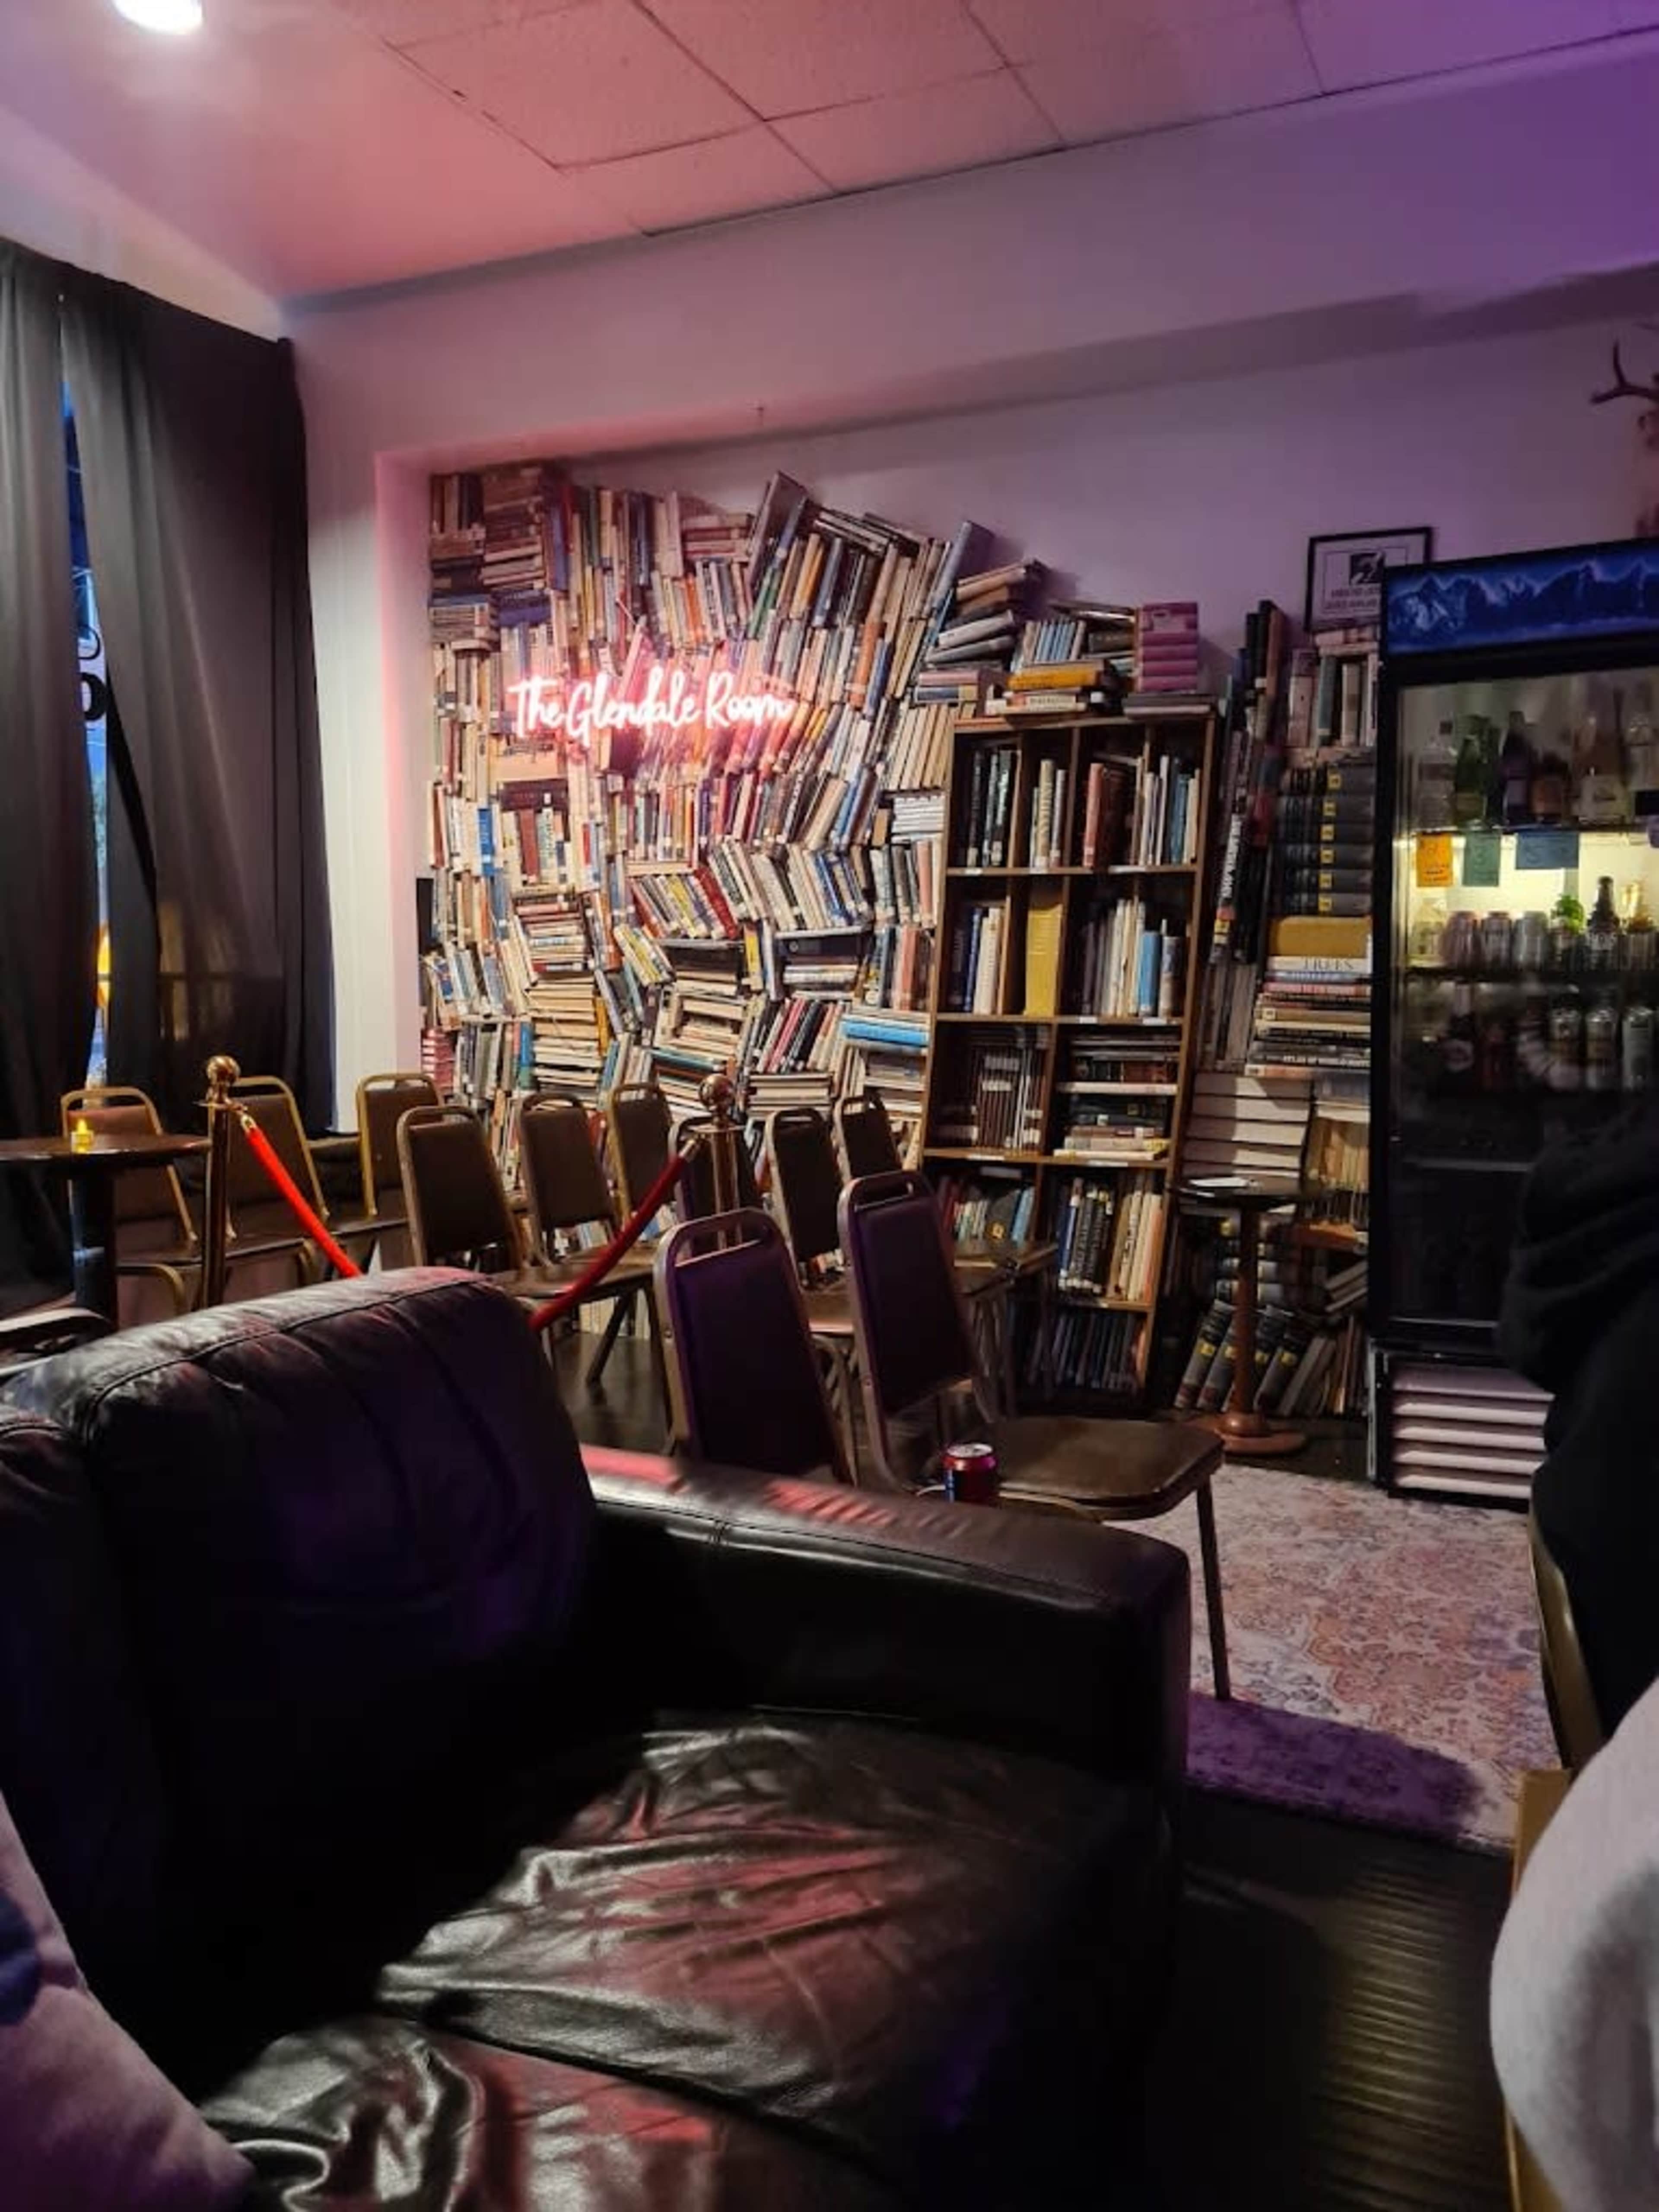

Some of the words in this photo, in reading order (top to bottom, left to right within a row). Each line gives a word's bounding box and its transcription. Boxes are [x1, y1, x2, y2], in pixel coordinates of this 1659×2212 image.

[507, 675, 563, 738] The
[566, 665, 701, 748] Glendale
[706, 671, 797, 729] Room
